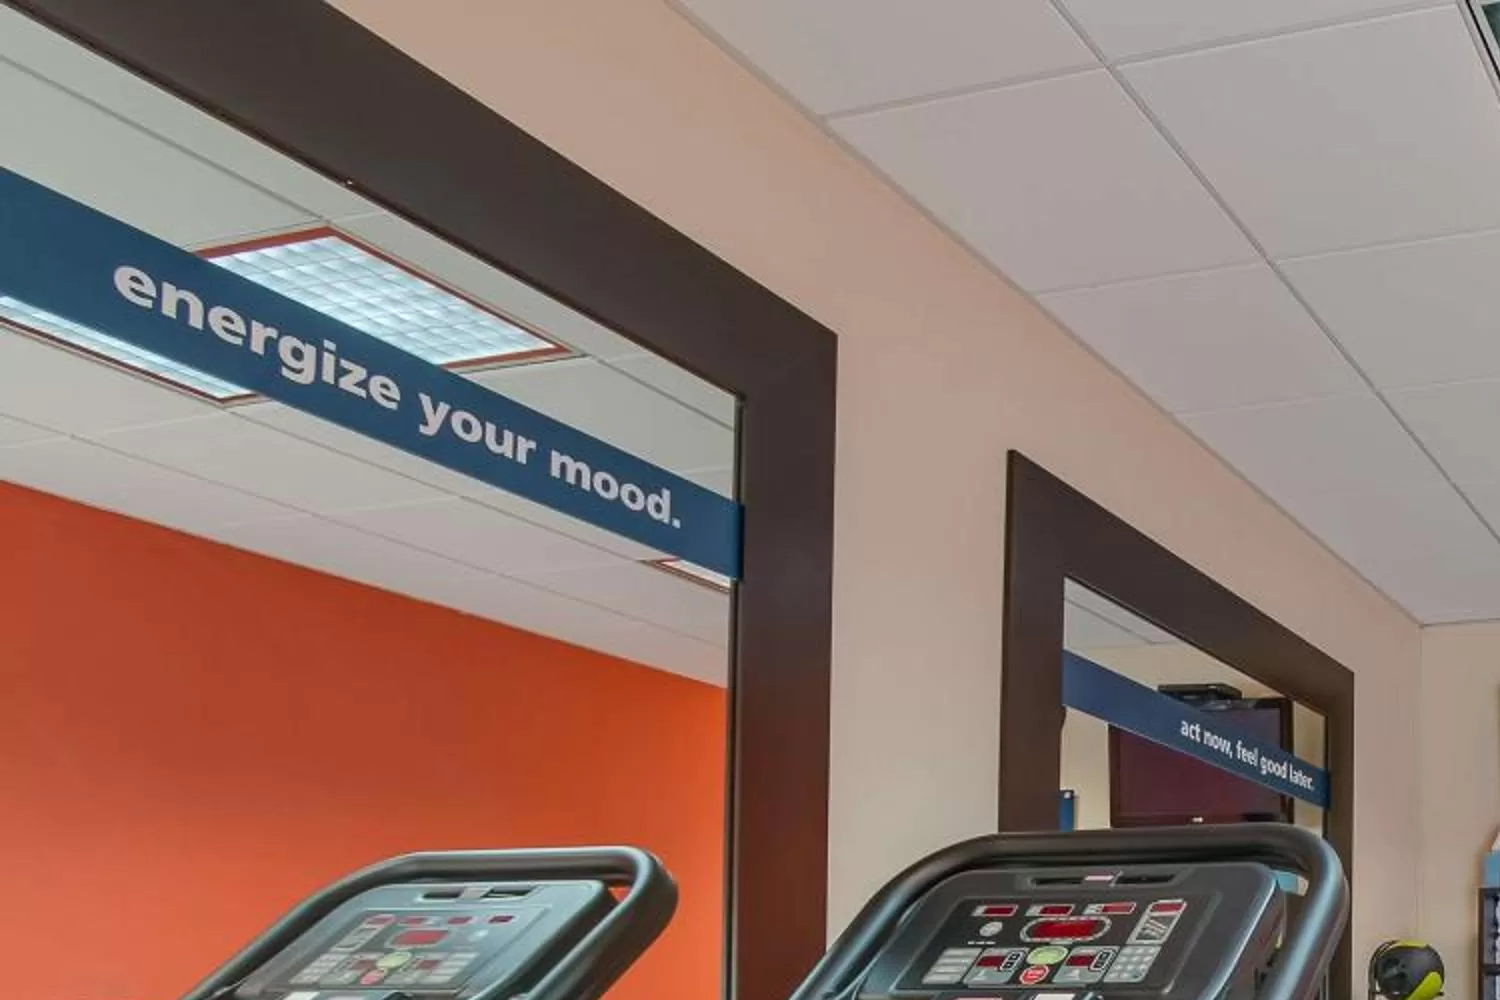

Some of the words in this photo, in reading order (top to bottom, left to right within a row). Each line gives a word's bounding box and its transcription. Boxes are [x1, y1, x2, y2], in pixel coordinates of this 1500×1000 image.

[113, 264, 401, 412] energize
[418, 392, 538, 466] your
[550, 449, 682, 528] mood.
[1181, 720, 1201, 742] act
[1203, 731, 1233, 759] now,
[1236, 740, 1259, 766] feel
[1260, 756, 1288, 779] good
